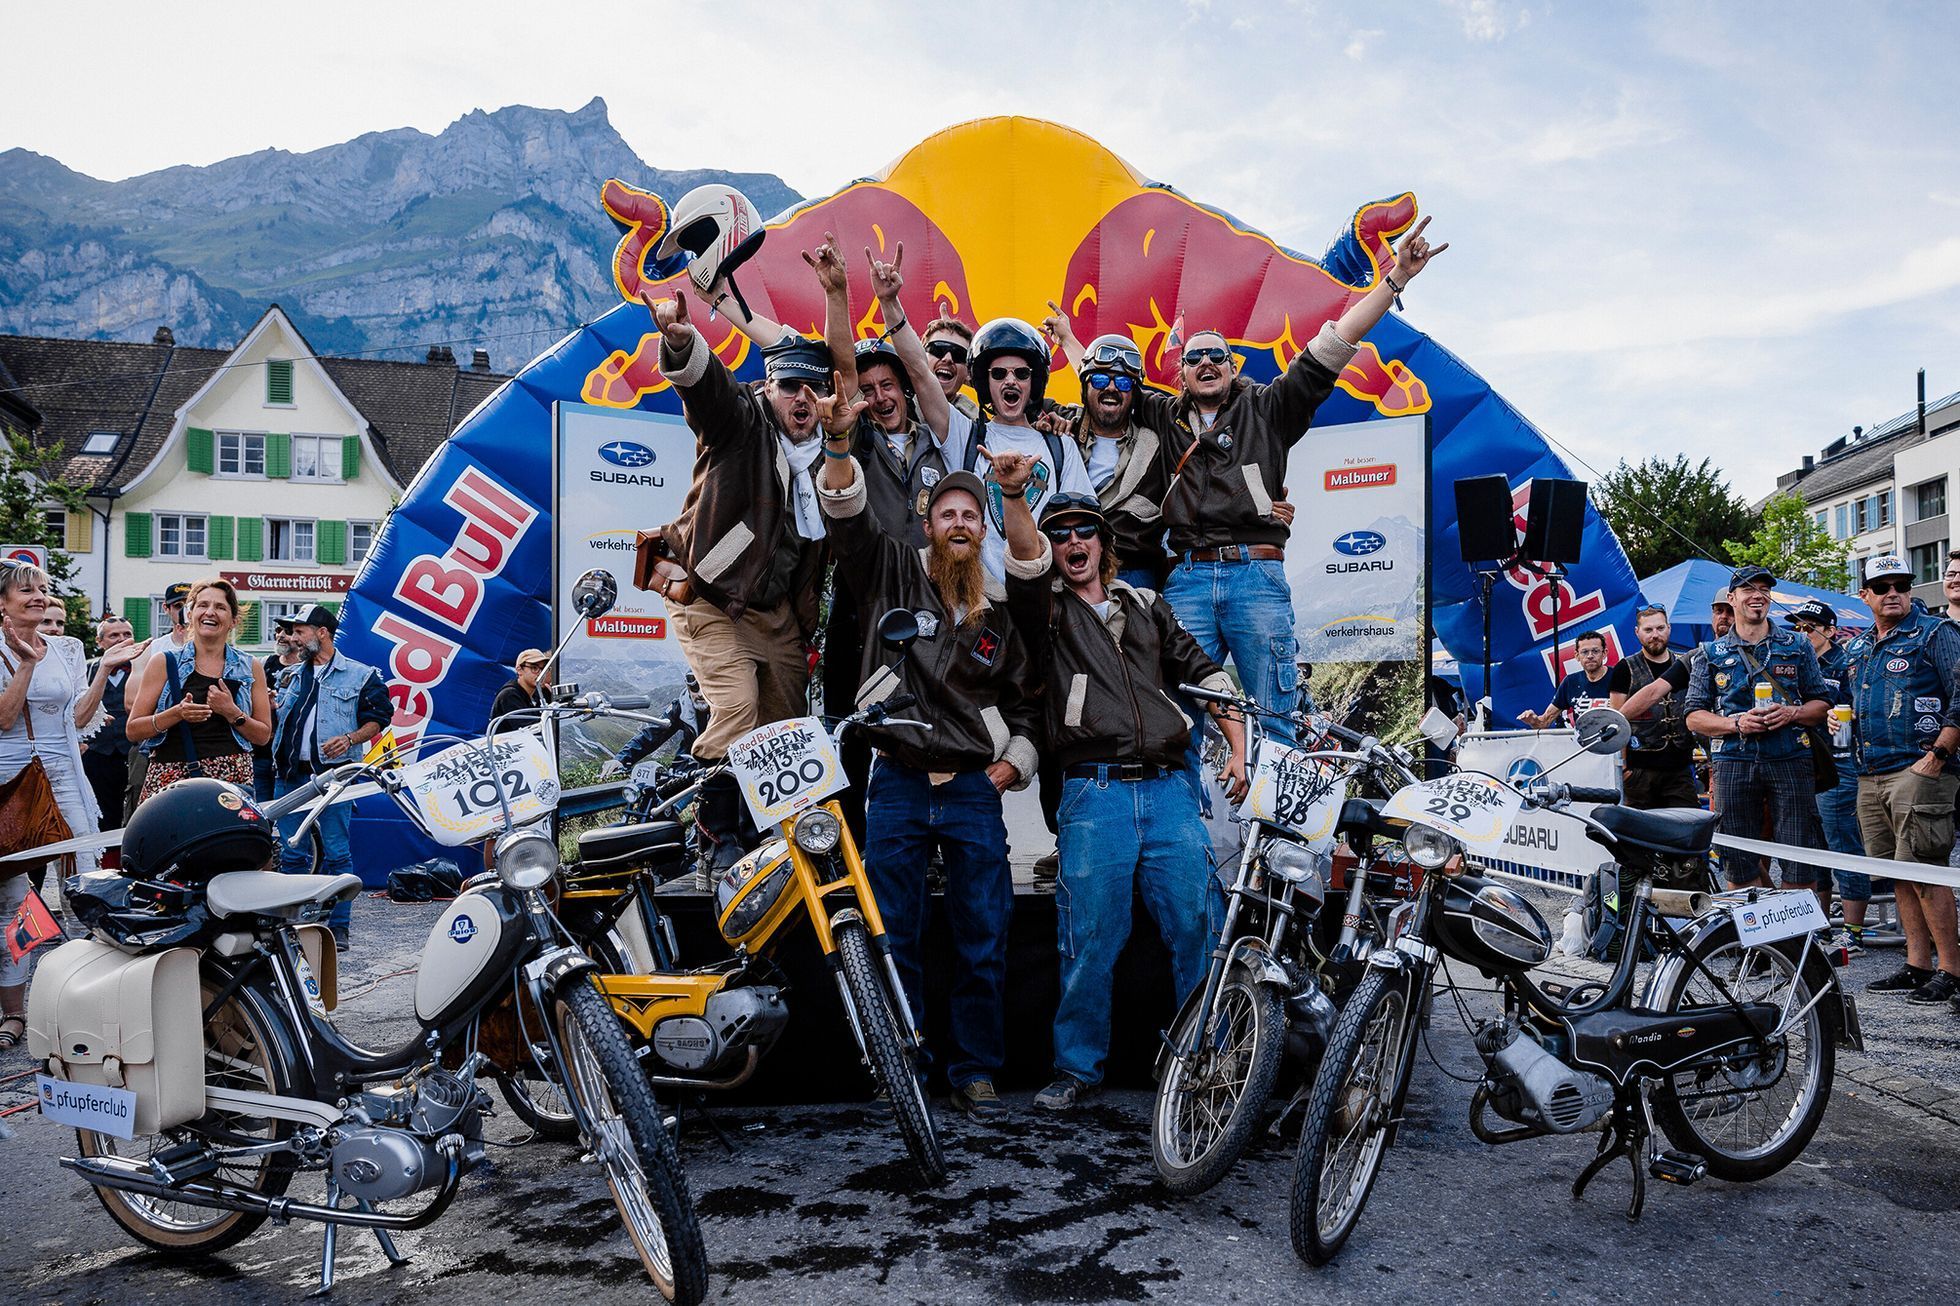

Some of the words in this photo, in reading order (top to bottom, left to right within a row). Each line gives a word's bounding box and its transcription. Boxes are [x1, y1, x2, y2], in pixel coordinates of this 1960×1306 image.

[590, 471, 664, 487] SUBARU
[1331, 472, 1389, 486] Malbuner
[399, 470, 532, 628] Bull
[590, 539, 638, 552] verkehrs
[1325, 560, 1394, 574] SUBARU
[1797, 602, 1823, 615] ACHS
[595, 620, 659, 634] Malbuner
[1325, 625, 1395, 638] verkehrshaus
[1889, 660, 1906, 670] STP
[365, 616, 454, 764] ed
[739, 735, 757, 753] Red
[757, 726, 777, 745] Bull
[749, 729, 809, 767] ALPEN
[421, 752, 451, 771] Red
[449, 743, 473, 759] Bul
[773, 752, 793, 773] 13
[1293, 753, 1310, 768] Bll
[468, 761, 493, 783] 13
[758, 758, 825, 808] 200
[453, 769, 531, 817] 102
[1289, 777, 1309, 799] 13
[1432, 778, 1500, 805] ALPEN
[1444, 787, 1468, 802] 13
[1424, 797, 1472, 823] 29
[1503, 825, 1559, 851] SUBARU
[1761, 900, 1815, 928] pfupferclub
[56, 1090, 128, 1118] pfupferclub
